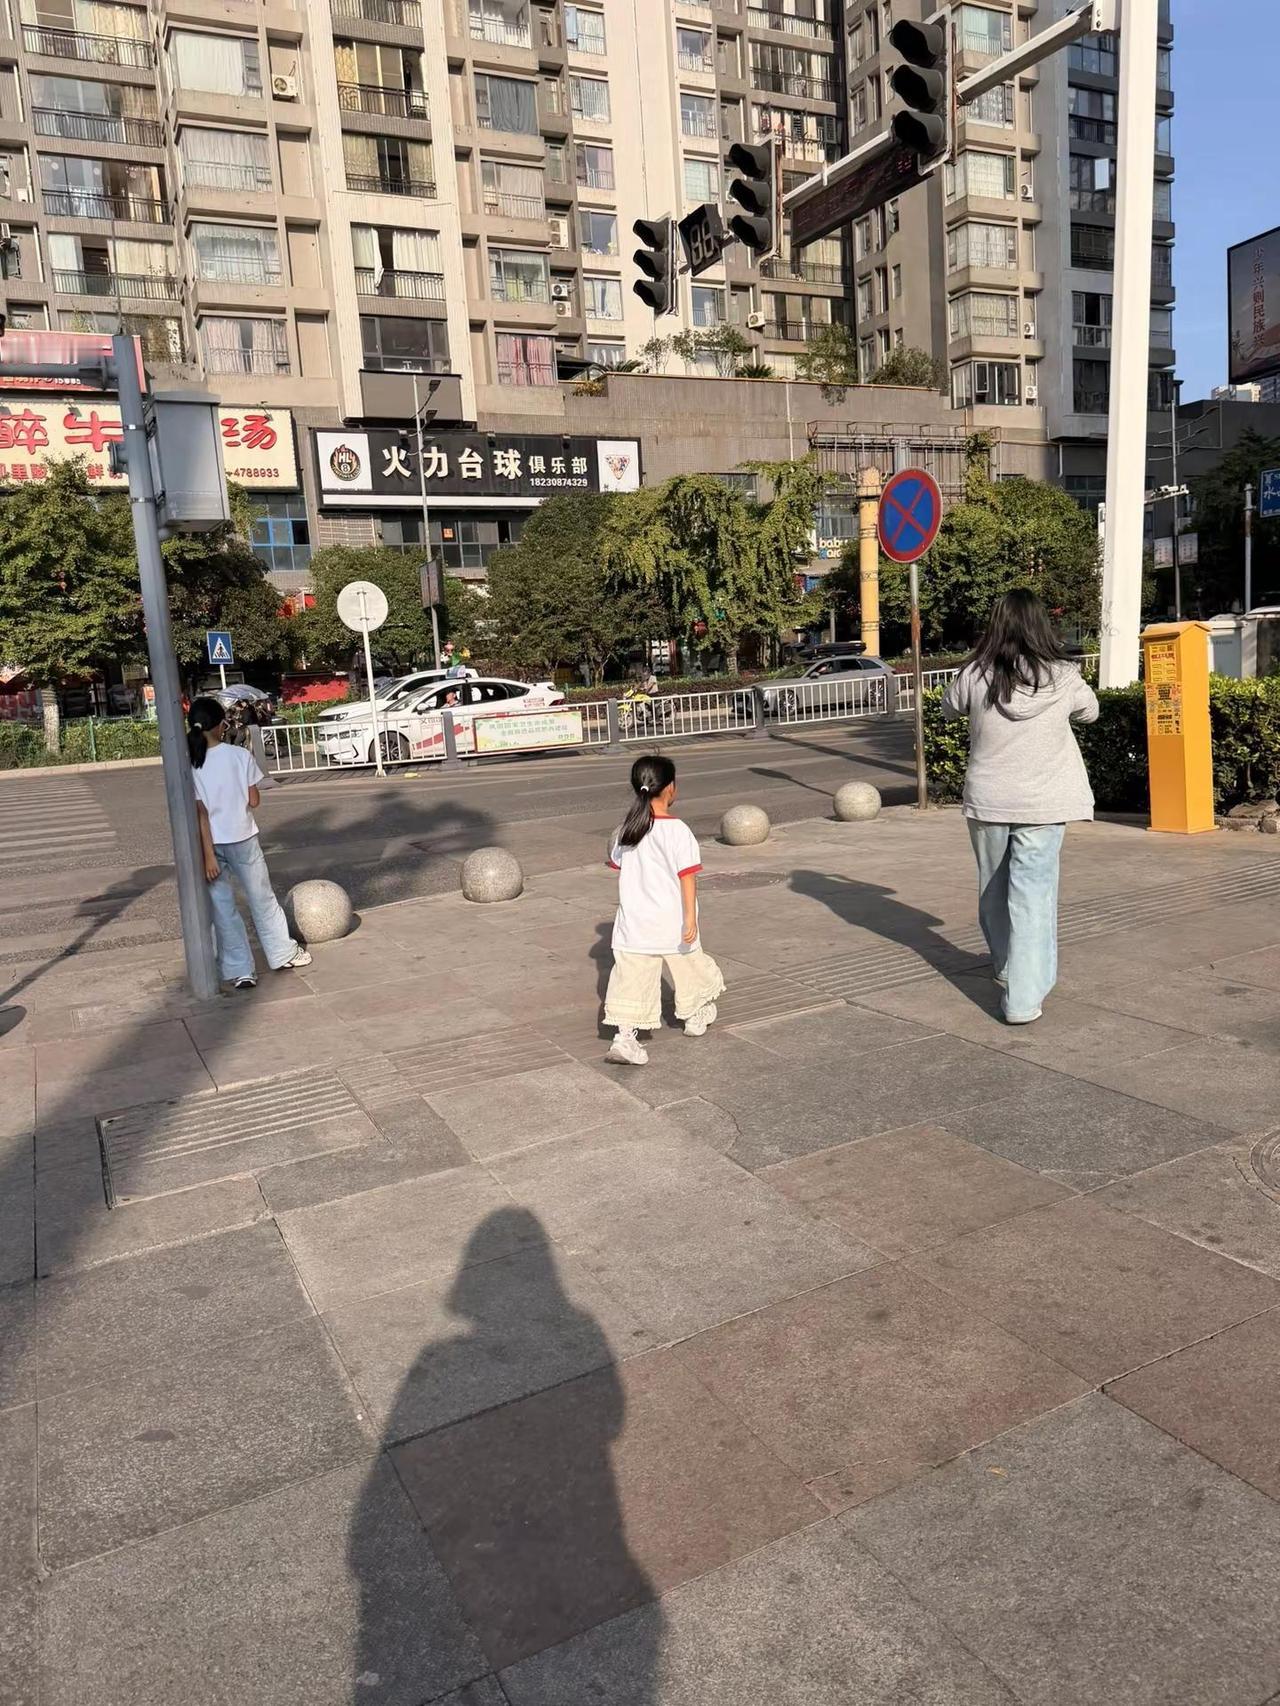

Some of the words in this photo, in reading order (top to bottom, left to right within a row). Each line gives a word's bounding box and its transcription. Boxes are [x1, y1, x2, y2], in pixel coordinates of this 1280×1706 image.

[1252, 246, 1265, 350] 少年兴则民族兴
[339, 452, 352, 463] HL
[381, 446, 523, 480] 火力台球
[529, 455, 588, 475] 俱乐部
[342, 464, 349, 473] 8
[530, 478, 588, 487] 18230874329
